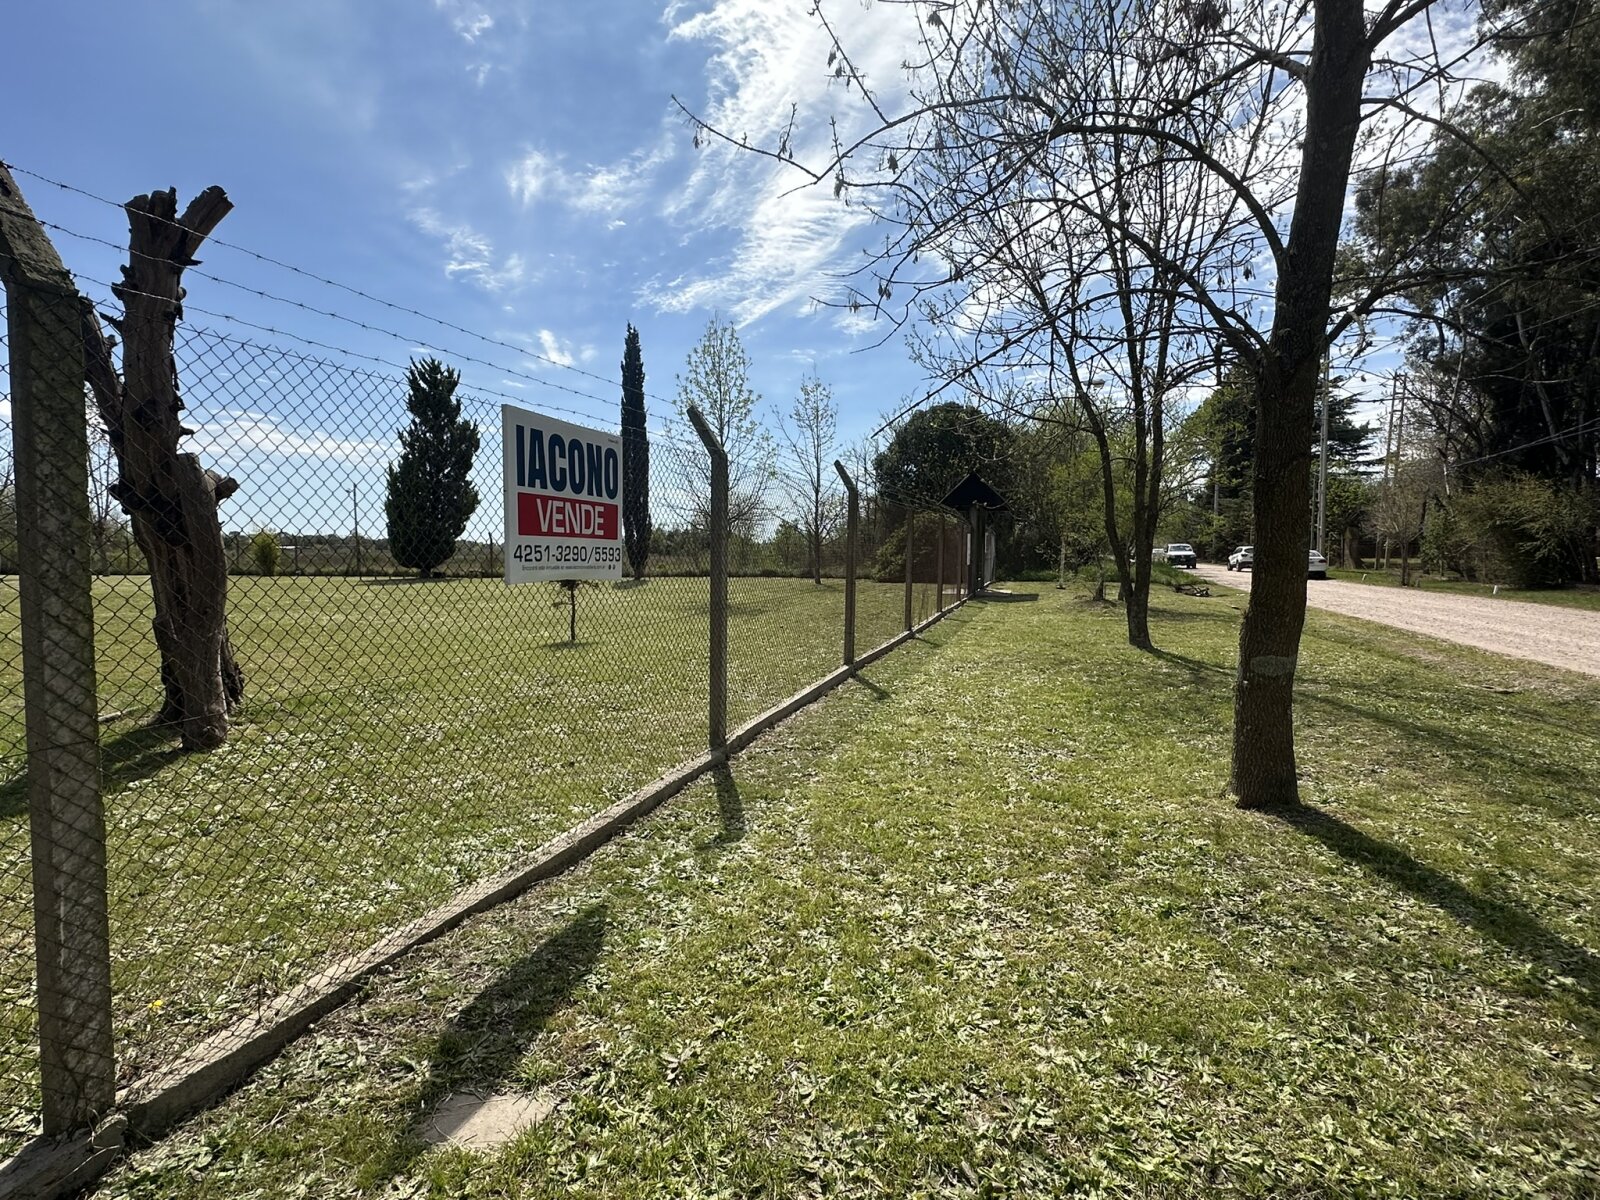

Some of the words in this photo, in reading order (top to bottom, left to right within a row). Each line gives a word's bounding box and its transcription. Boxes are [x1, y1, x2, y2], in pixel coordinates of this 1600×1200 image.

[515, 424, 619, 500] IACONO
[536, 498, 604, 536] VENDE
[513, 544, 621, 564] 4251-3290/5593
